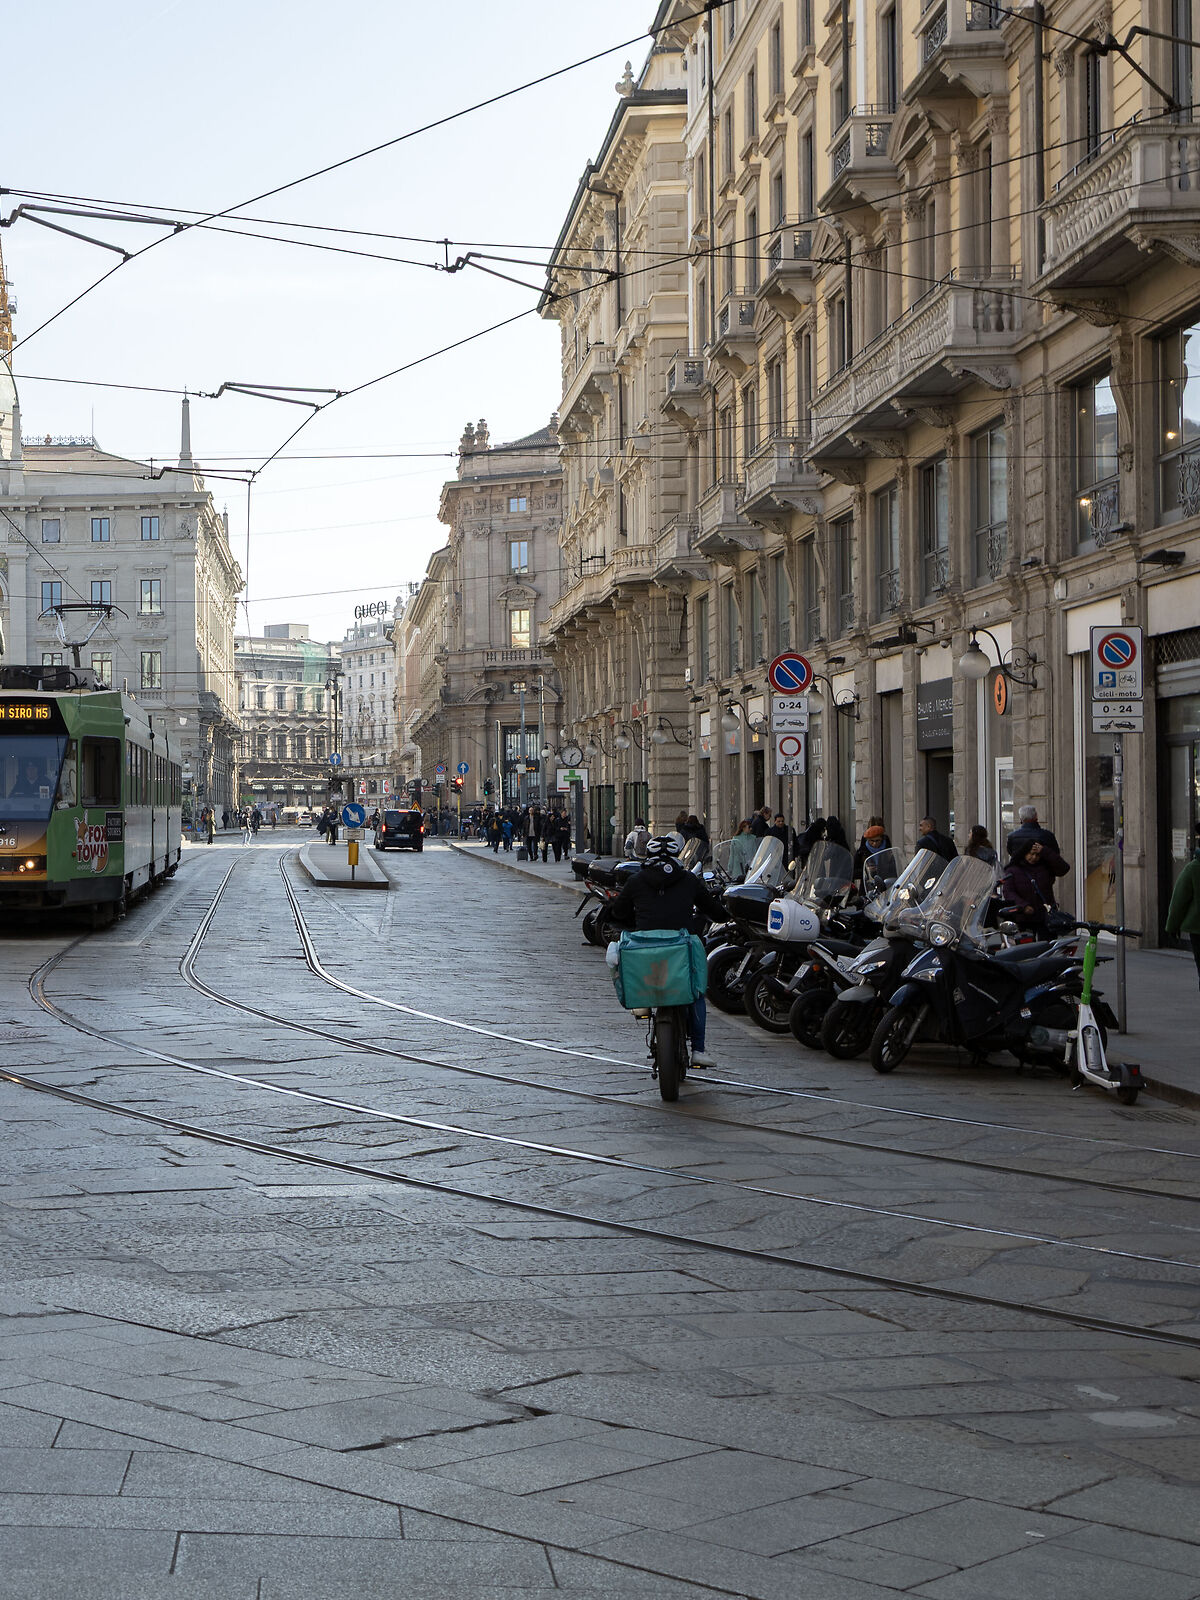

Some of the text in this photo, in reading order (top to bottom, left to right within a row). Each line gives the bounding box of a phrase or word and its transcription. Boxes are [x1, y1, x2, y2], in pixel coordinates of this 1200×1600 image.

[354, 600, 388, 620] GUCCI
[8, 707, 32, 719] SIRO
[35, 707, 49, 719] M5
[778, 701, 802, 710] 0-24
[88, 825, 108, 843] FOX
[77, 843, 109, 862] TOWN
